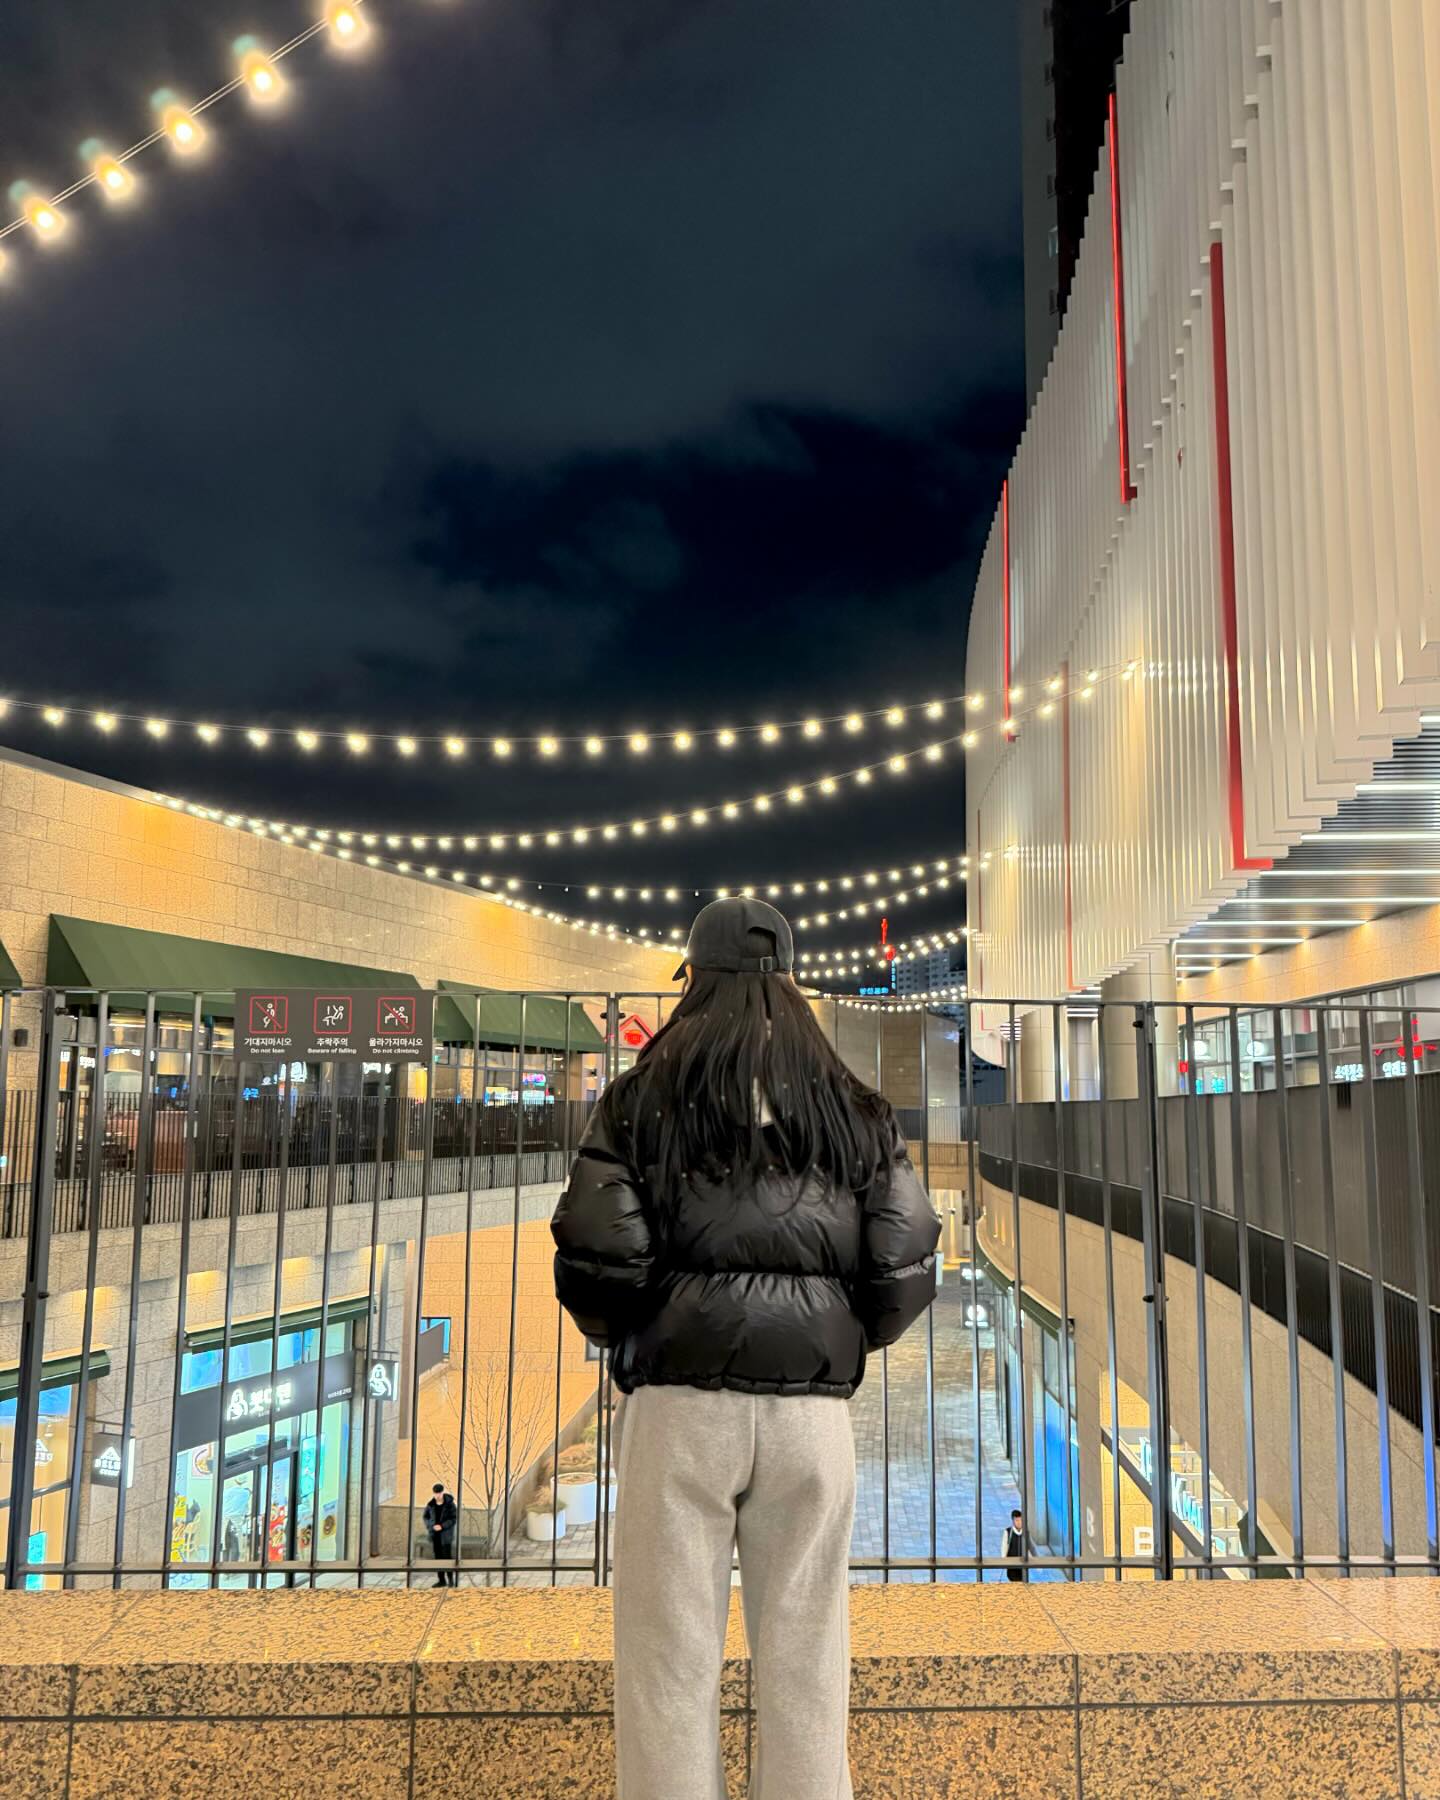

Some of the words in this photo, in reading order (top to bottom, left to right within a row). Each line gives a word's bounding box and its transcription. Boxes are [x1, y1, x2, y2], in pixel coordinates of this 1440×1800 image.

[244, 1037, 292, 1046] 기대지마시오
[316, 1037, 348, 1046] 추락주의
[369, 1037, 423, 1047] 올라가지마시오
